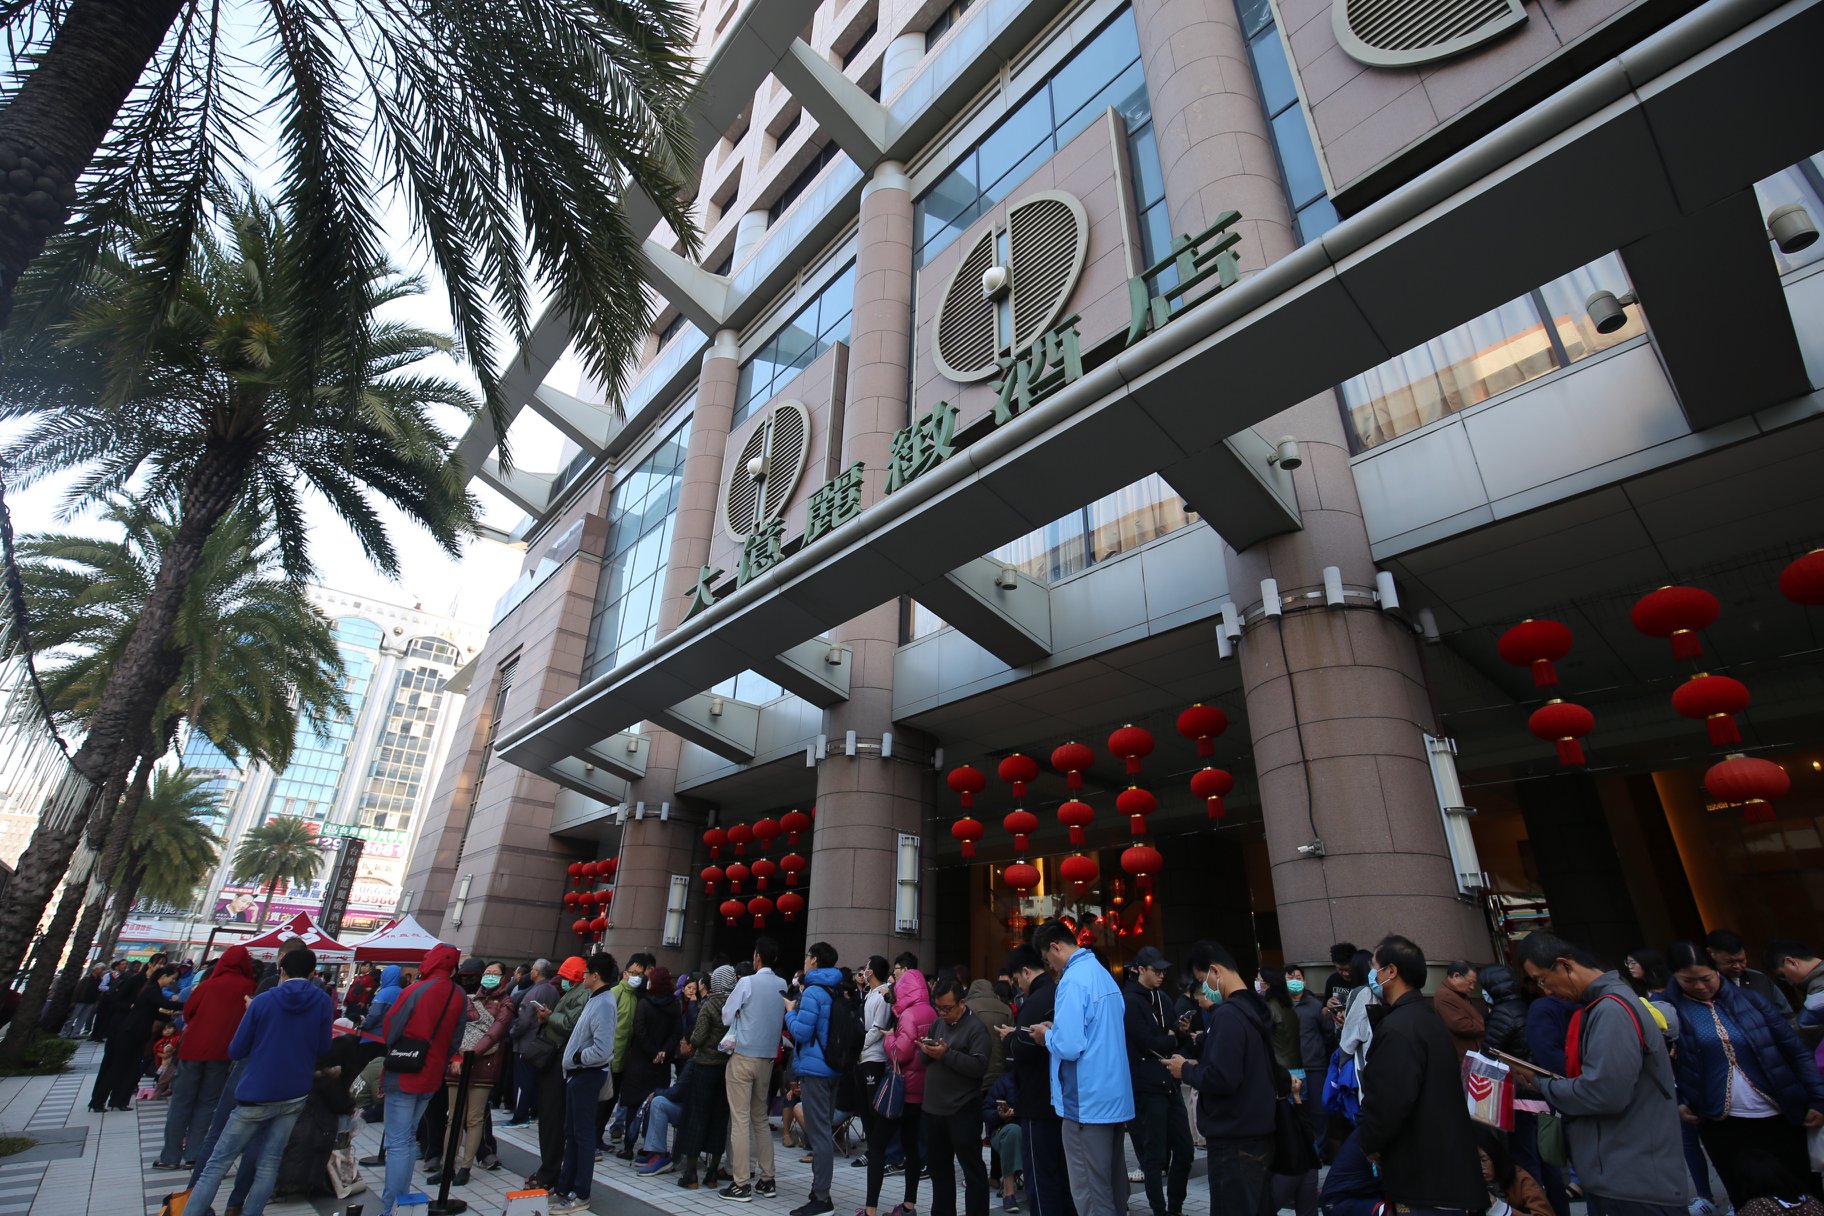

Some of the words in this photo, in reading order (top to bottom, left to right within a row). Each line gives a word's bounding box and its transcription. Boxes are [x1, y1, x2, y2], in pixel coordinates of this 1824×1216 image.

[678, 209, 1244, 624] 大億麗緻酒店
